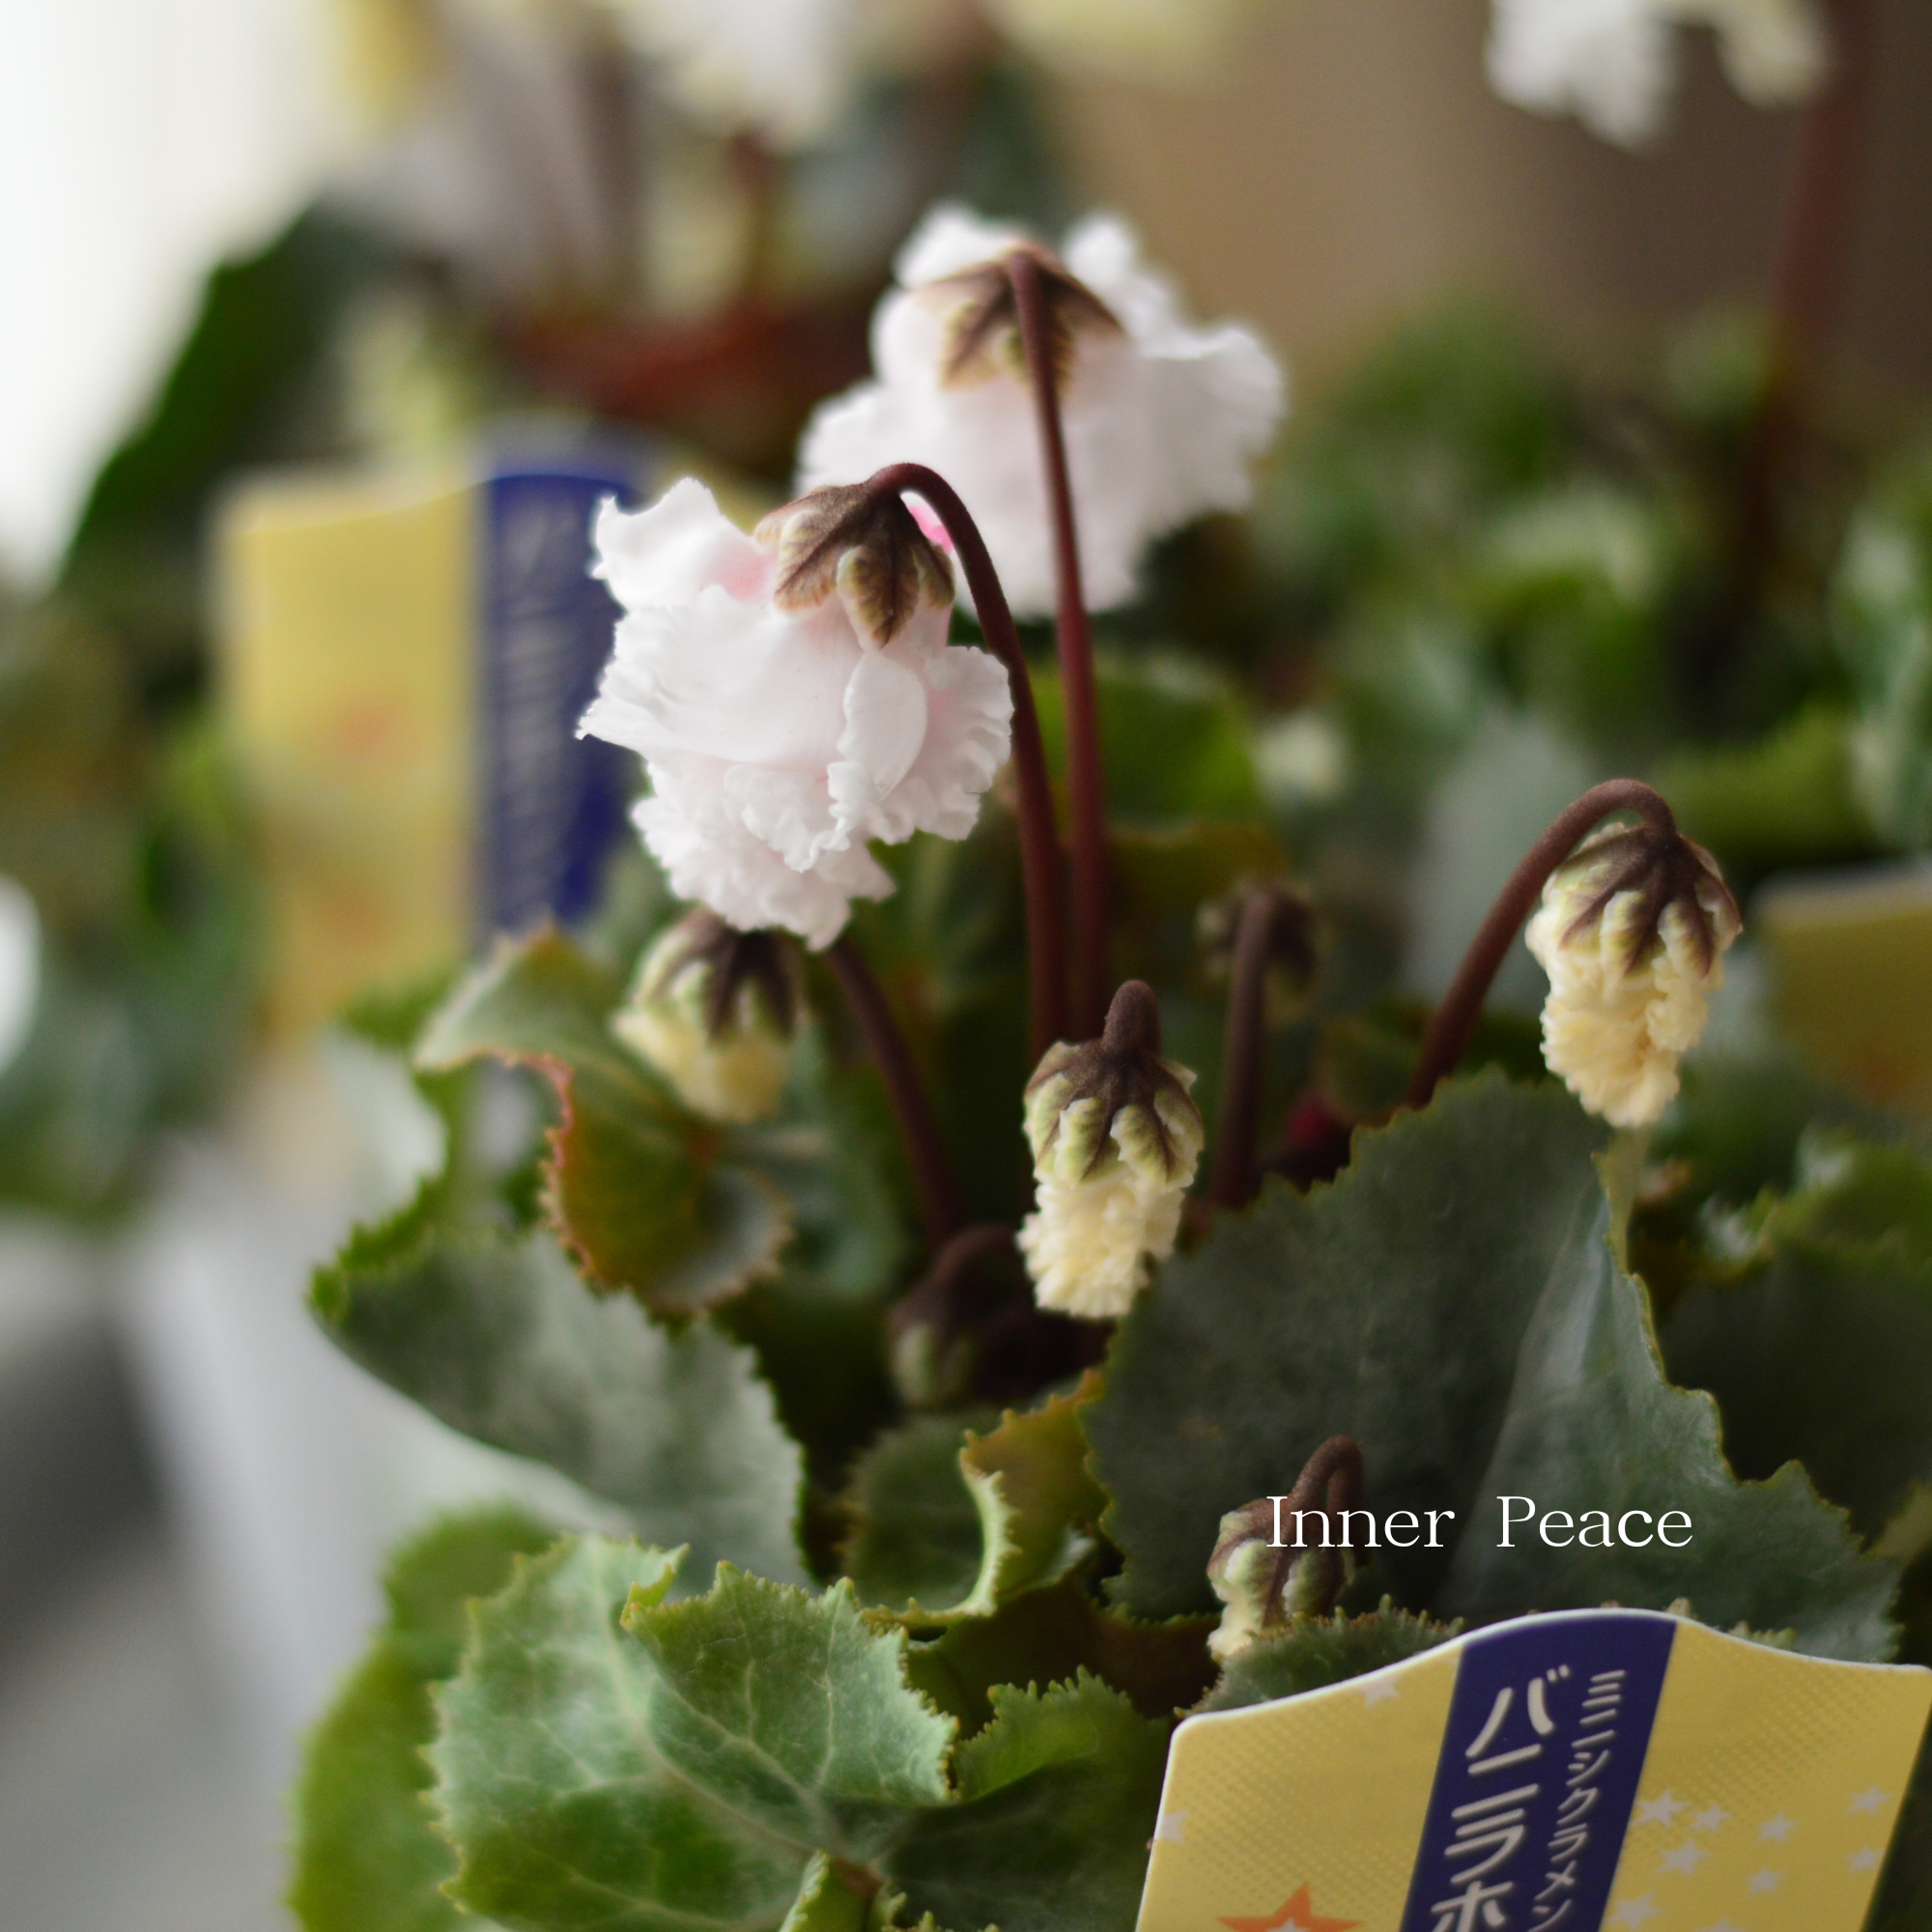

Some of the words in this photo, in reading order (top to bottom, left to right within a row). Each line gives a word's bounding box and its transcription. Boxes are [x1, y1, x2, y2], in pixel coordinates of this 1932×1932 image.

[1527, 1669, 1625, 1932] ミニシクラメン
